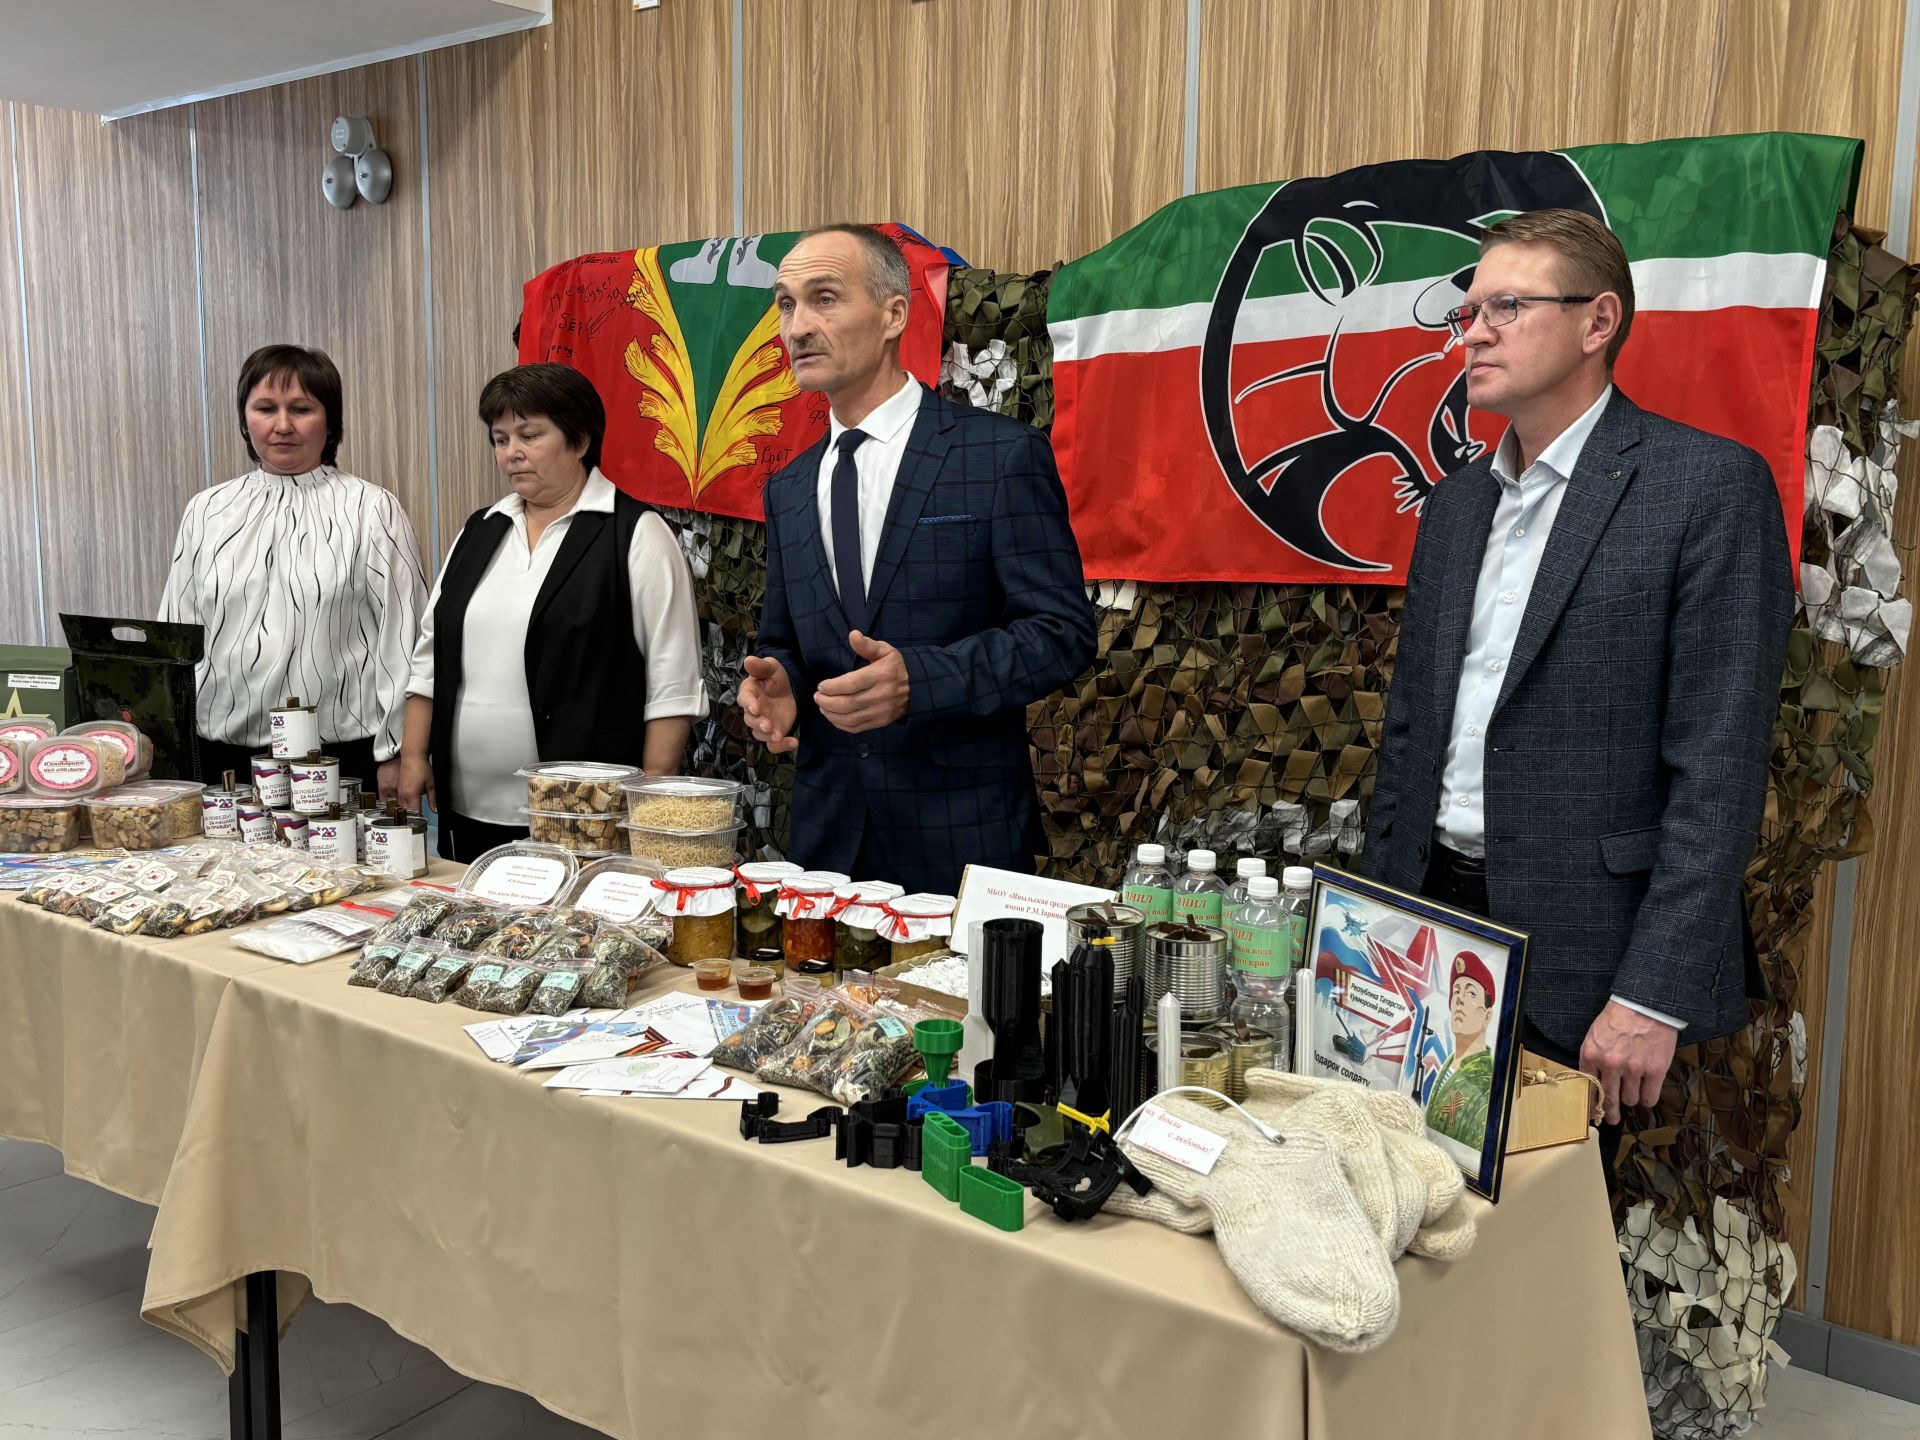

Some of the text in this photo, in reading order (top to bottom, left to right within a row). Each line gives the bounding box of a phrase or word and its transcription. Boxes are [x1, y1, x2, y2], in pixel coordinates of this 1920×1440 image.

[312, 771, 328, 781] 23
[219, 799, 234, 809] 23
[321, 827, 337, 838] 23
[375, 832, 388, 843] 23
[986, 887, 1008, 897] МБОУ
[1004, 903, 1025, 912] имени
[1176, 896, 1207, 909] ЯНИЛ
[1350, 982, 1406, 1012] Республика Татарстан
[1349, 993, 1395, 1018] Кукморский район
[1340, 1066, 1371, 1087] солдату
[1175, 1135, 1214, 1154] любовью!
